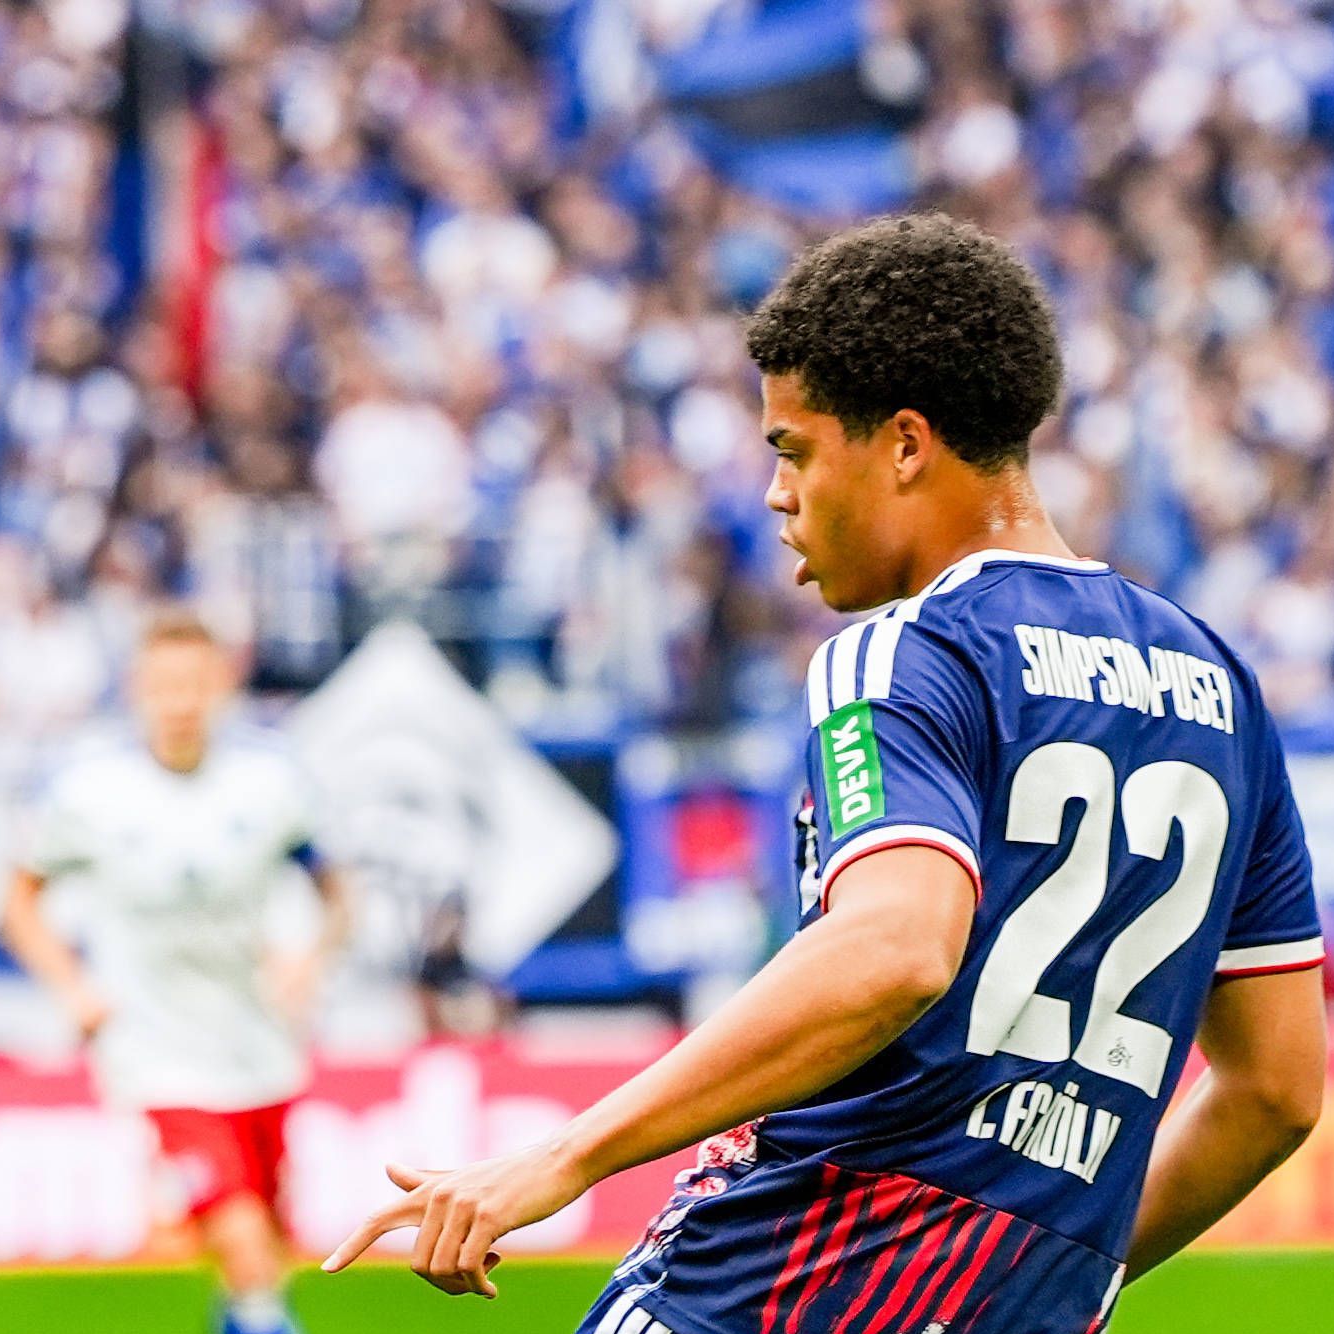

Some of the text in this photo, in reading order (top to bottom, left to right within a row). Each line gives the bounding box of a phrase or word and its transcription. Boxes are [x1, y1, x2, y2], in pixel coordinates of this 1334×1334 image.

[1013, 623, 1235, 735] SIMPSONPUSEY
[830, 715, 871, 825] DEVK
[965, 741, 1230, 1099] 22
